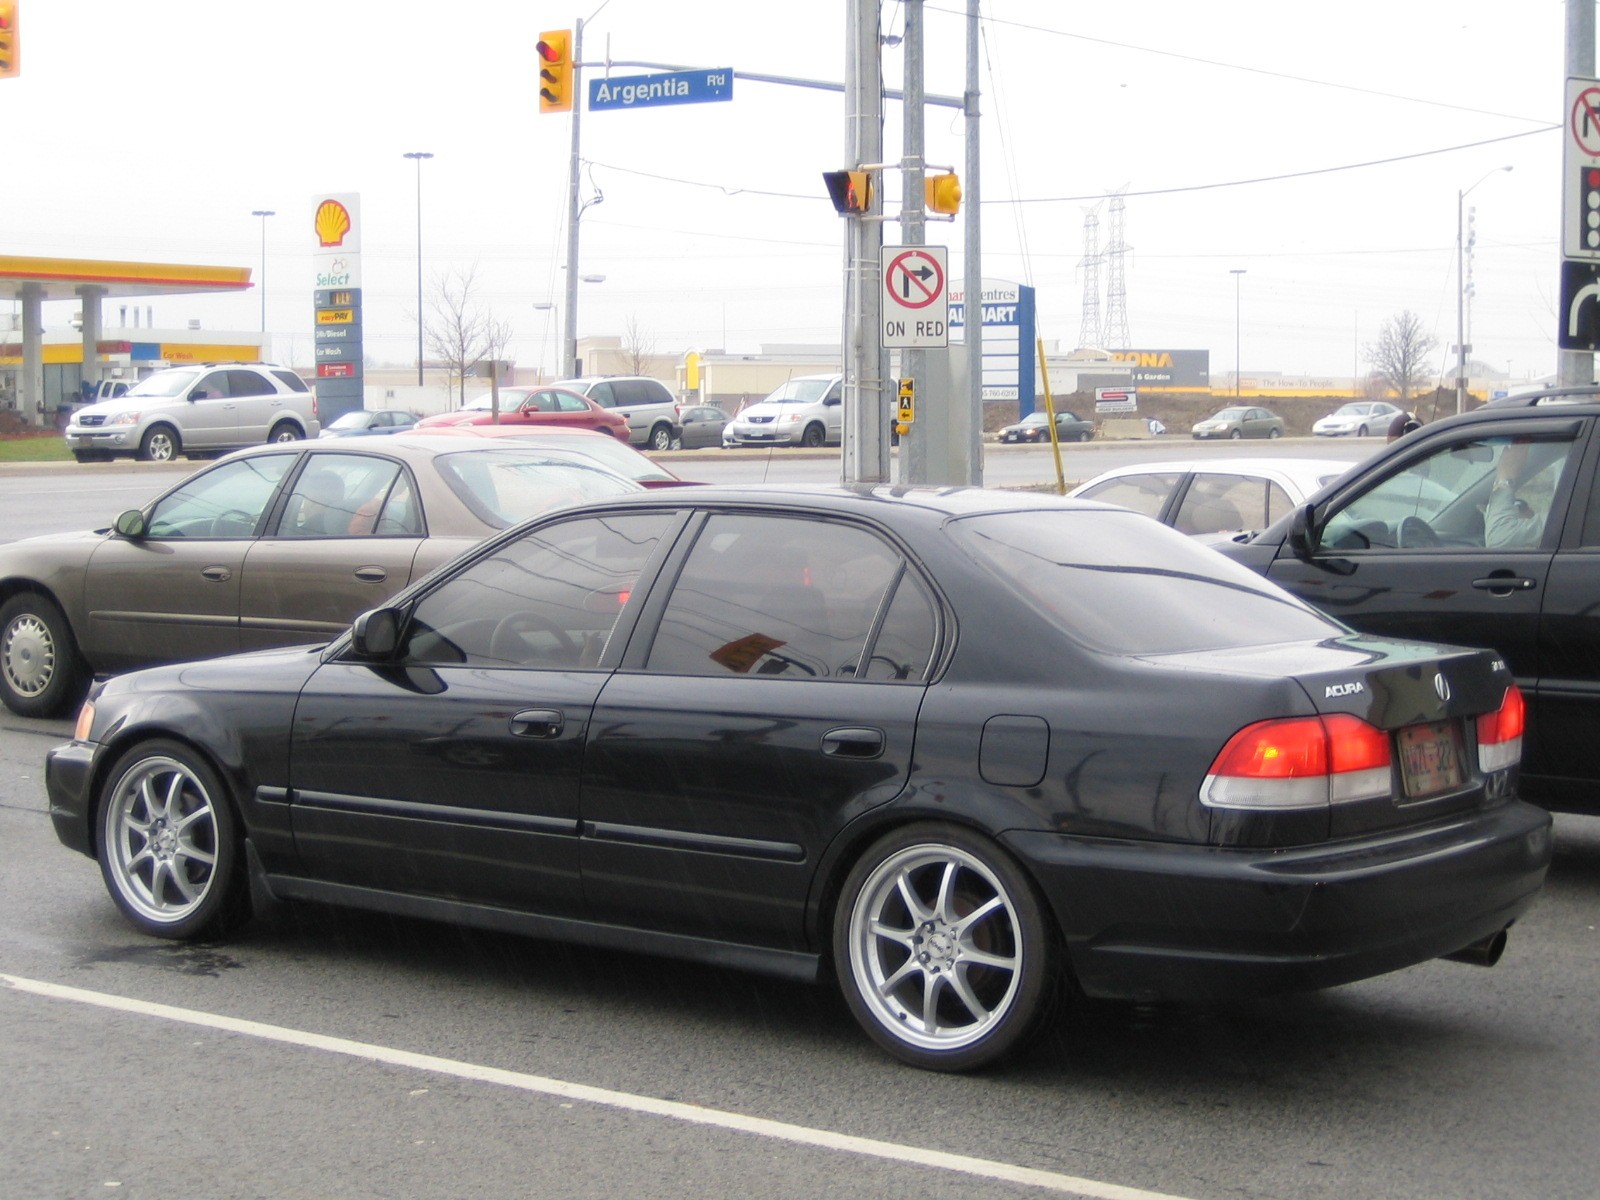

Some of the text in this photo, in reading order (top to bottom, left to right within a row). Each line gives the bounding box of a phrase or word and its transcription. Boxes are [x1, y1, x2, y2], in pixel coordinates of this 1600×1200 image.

[596, 75, 725, 104] Argentia Rd
[316, 274, 350, 287] Select
[886, 321, 944, 337] ON RED
[325, 347, 342, 355] Wash
[1112, 351, 1174, 368] RONA
[1325, 682, 1363, 698] ACURA
